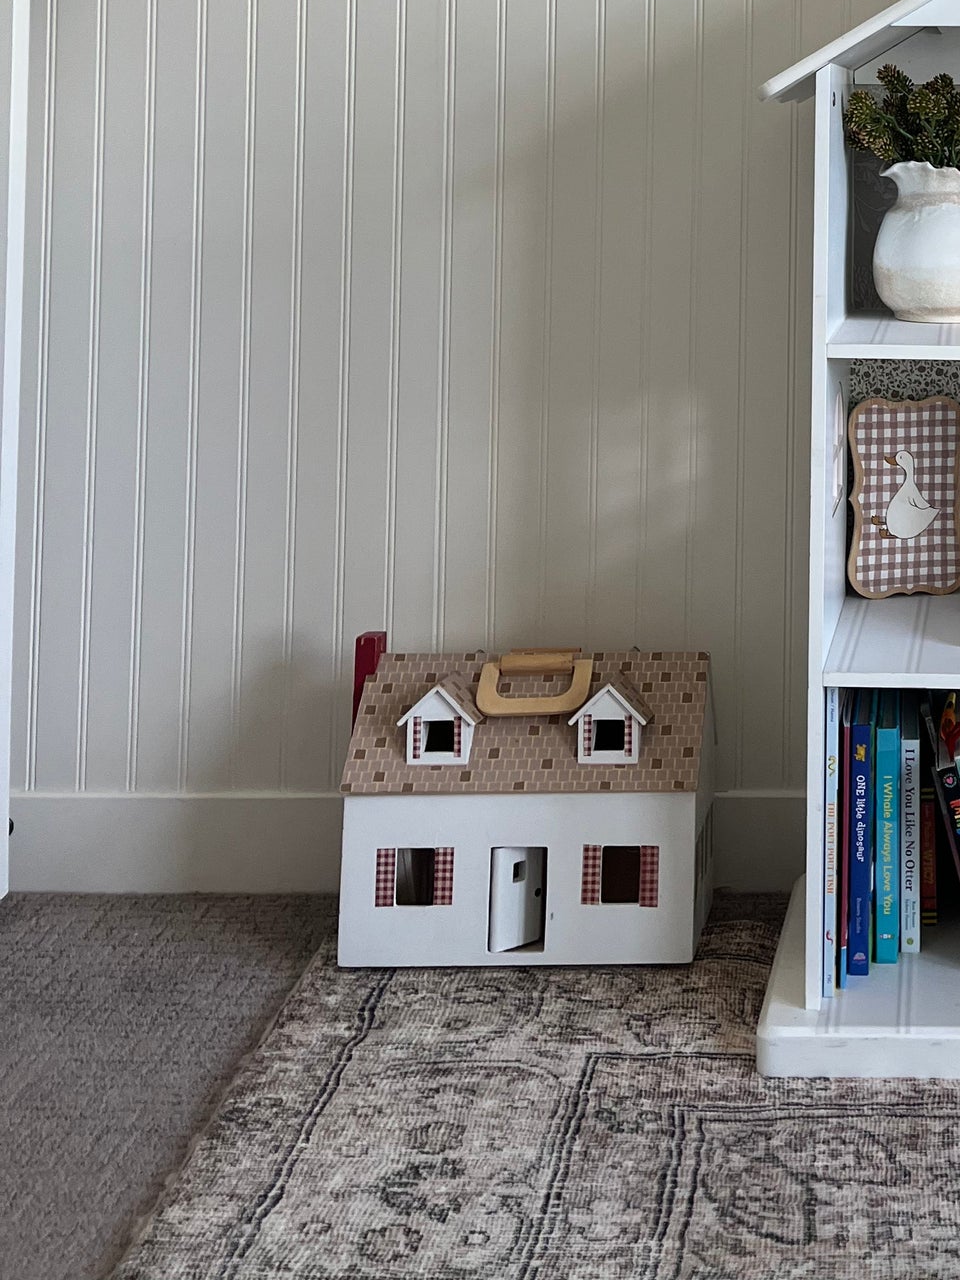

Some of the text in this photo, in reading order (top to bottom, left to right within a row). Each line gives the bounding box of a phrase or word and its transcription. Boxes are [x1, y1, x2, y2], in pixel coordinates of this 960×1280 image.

[905, 757, 915, 784] Love
[884, 782, 893, 818] Whale
[905, 787, 915, 808] You
[856, 775, 866, 862] ONE little dinosaur
[905, 812, 915, 837] Like
[881, 821, 893, 862] Always
[905, 840, 915, 856] No
[826, 874, 834, 894] FISH
[884, 866, 892, 891] Love
[905, 860, 915, 891] Otter
[884, 895, 893, 914] You
